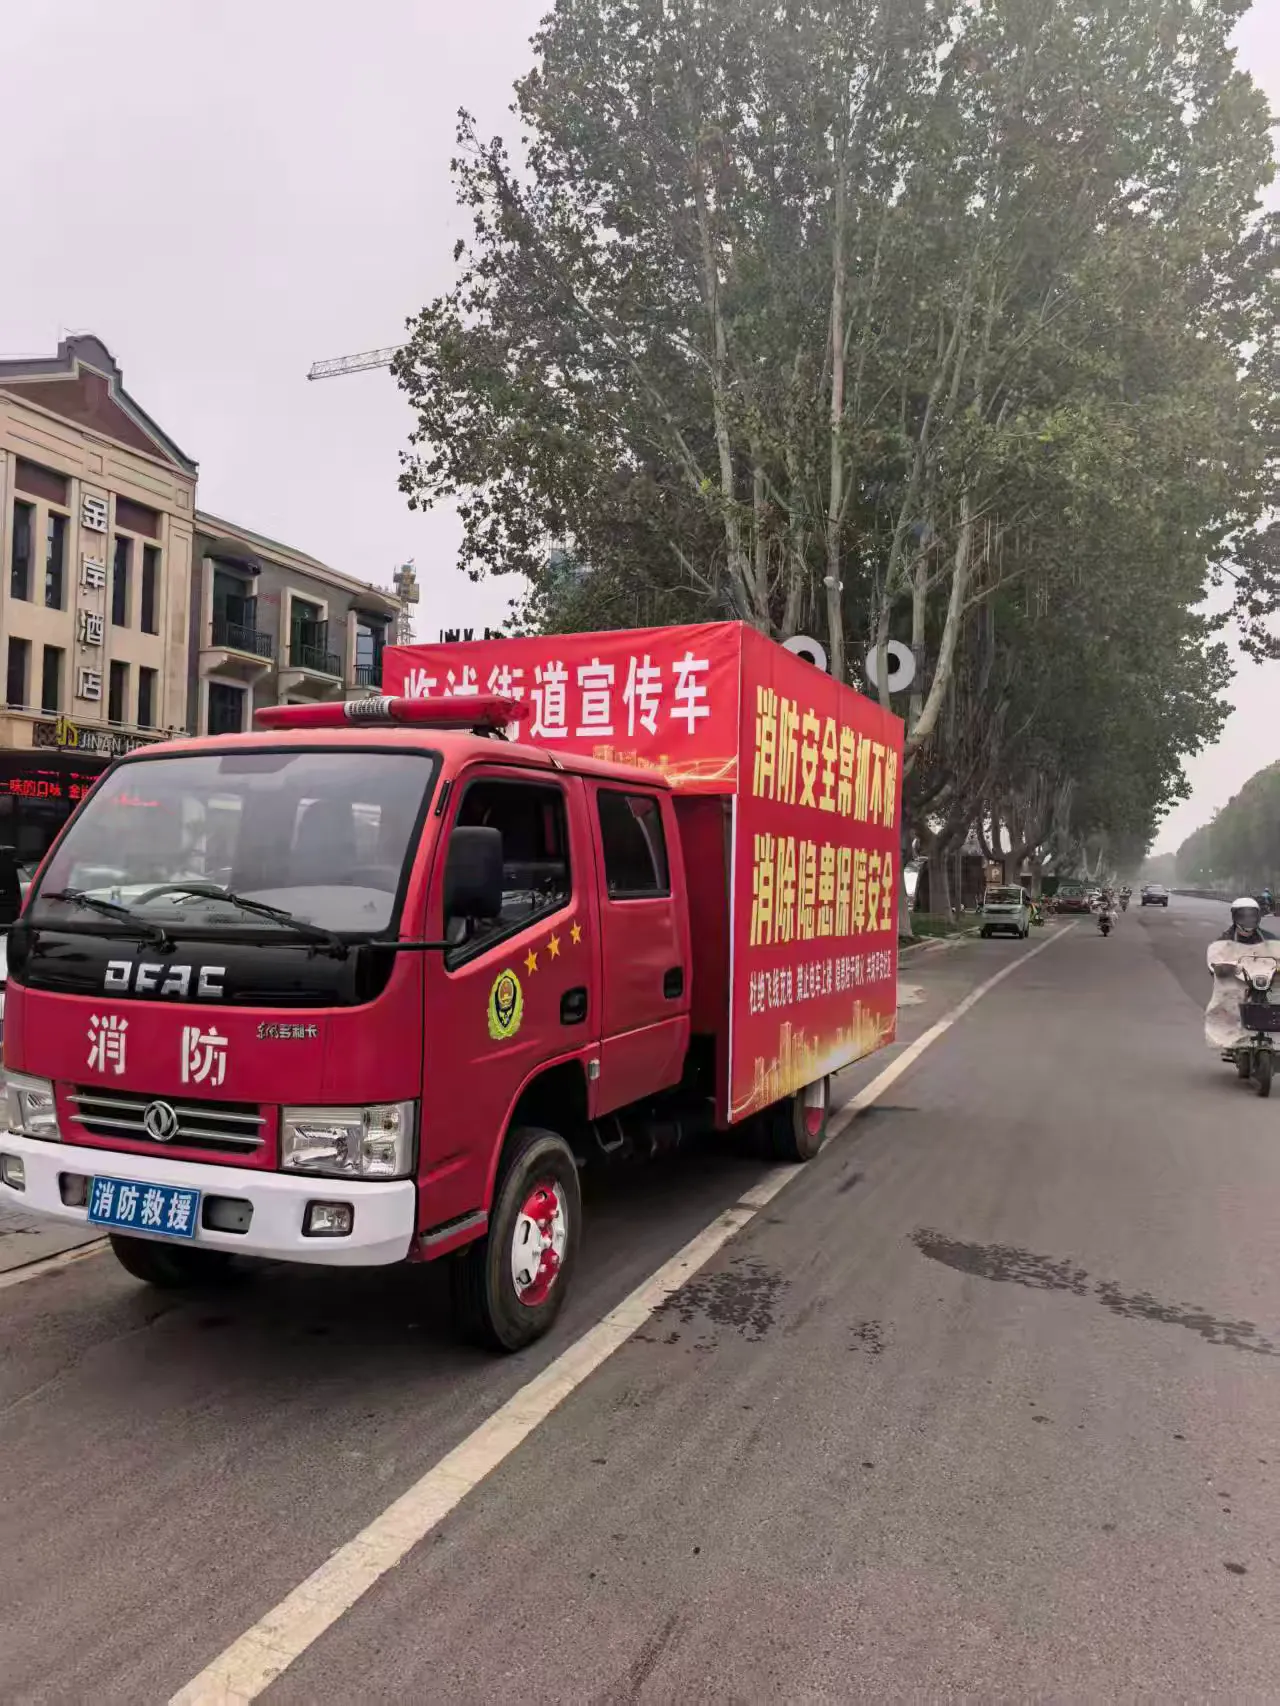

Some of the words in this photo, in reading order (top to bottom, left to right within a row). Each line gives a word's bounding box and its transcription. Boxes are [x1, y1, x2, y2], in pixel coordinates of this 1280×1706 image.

[77, 493, 109, 702] 金岸酒店
[79, 732, 121, 752] JINAN
[753, 685, 897, 829] 消防安全常抓不懈
[750, 832, 893, 946] 消除隐患保障安全
[104, 960, 228, 998] DFAC
[86, 1014, 229, 1087] 消防
[92, 1181, 192, 1232] 消防救援
